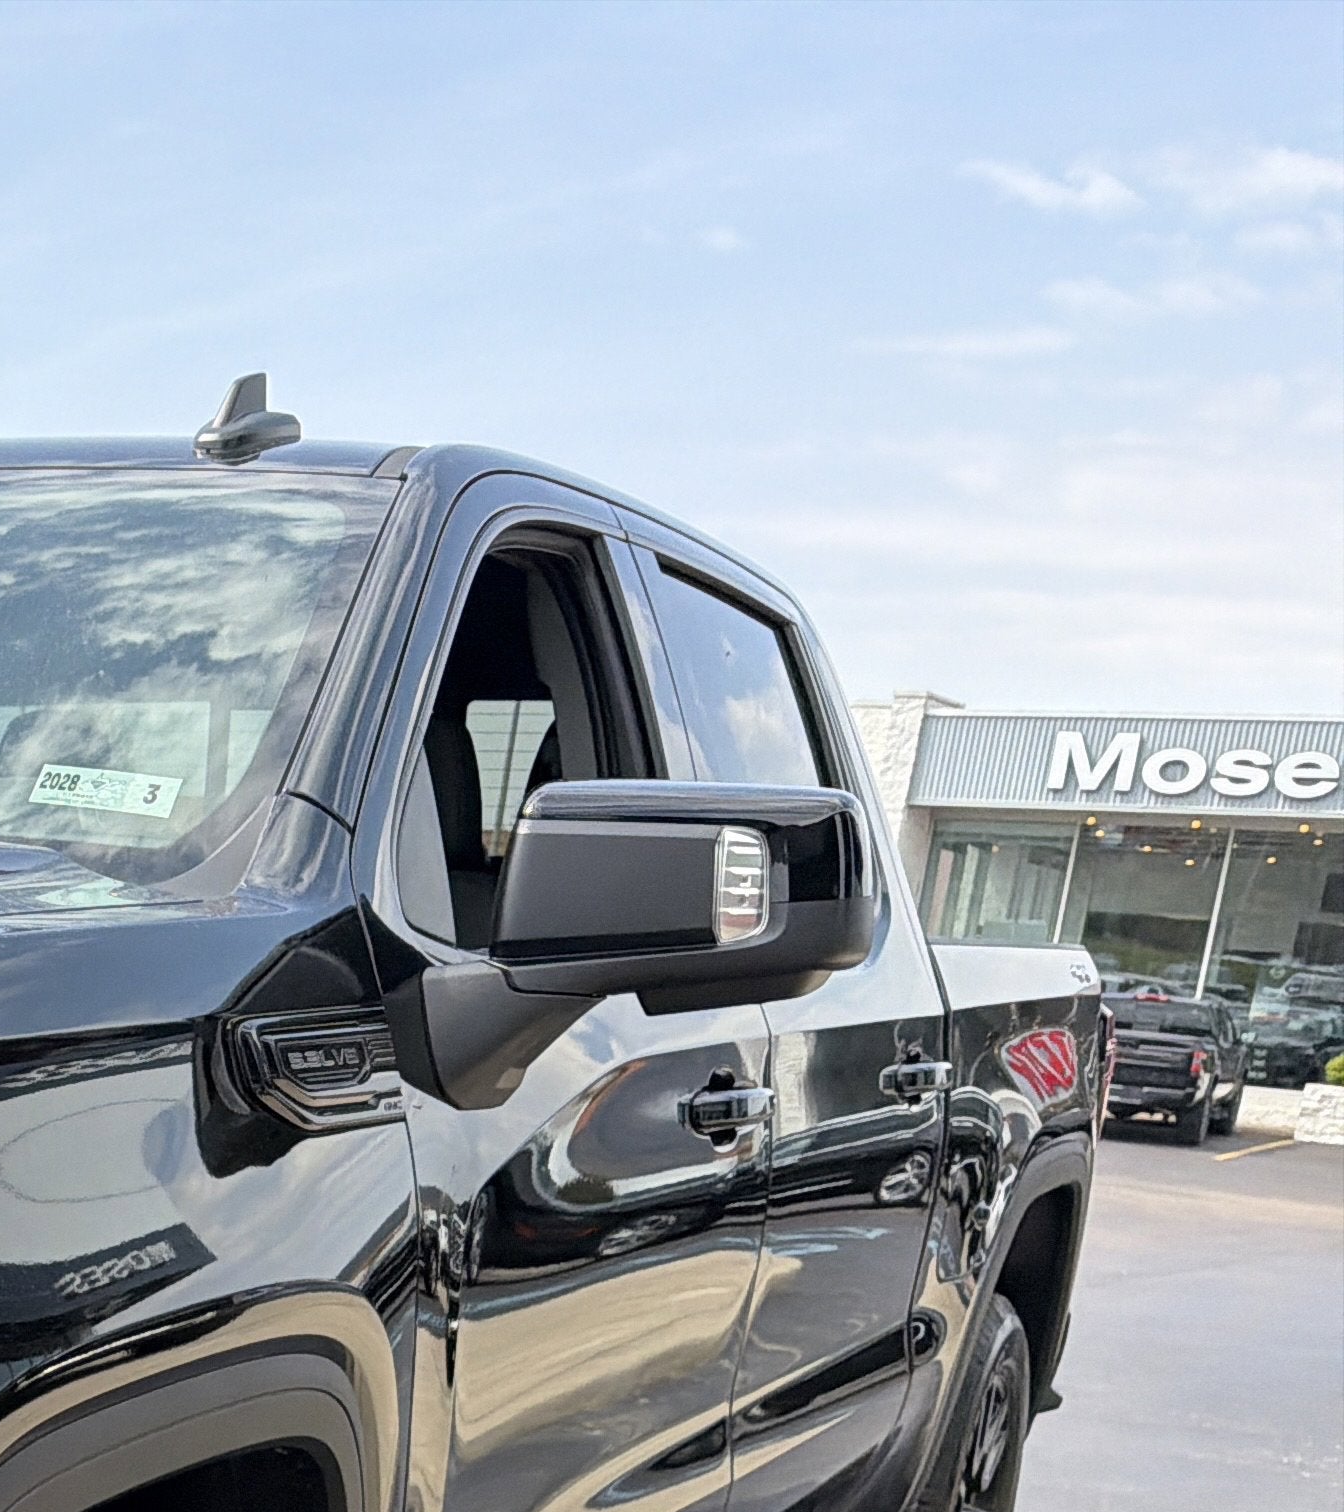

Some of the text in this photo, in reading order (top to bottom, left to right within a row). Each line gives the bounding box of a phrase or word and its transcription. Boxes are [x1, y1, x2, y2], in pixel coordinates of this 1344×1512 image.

[39, 771, 163, 804] 2028 3
[1046, 730, 1341, 800] Mose
